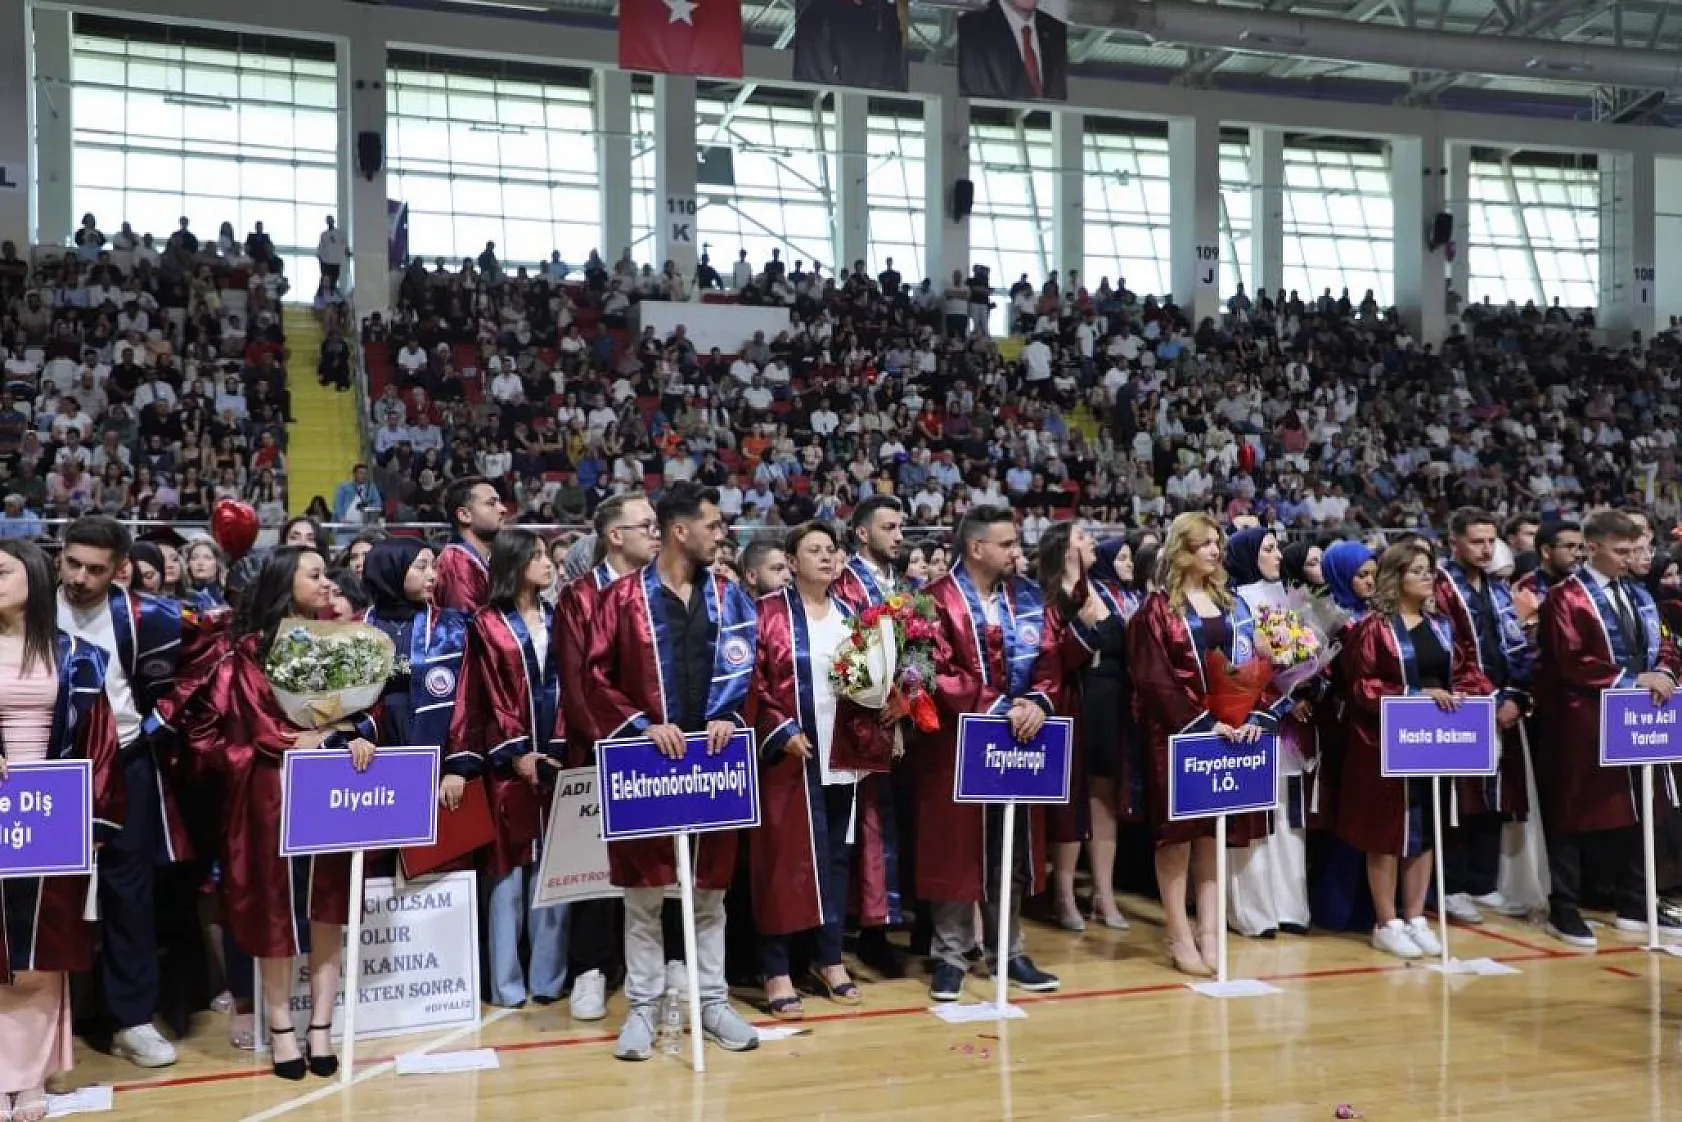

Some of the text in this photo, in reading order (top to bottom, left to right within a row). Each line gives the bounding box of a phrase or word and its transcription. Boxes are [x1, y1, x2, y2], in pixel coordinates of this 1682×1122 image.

[667, 198, 696, 215] 110
[673, 223, 690, 242] K
[1196, 245, 1219, 261] 109
[1201, 267, 1214, 284] J
[1398, 727, 1477, 744] Hasta Bakımı
[984, 743, 1046, 776] Fizyoterapi
[1184, 748, 1267, 775] Fizyoterapi
[611, 760, 747, 801] Elektronörofizyoloji
[1211, 771, 1240, 793] İ.Ö.
[20, 790, 53, 817] Diş
[329, 786, 396, 812] Diyaliz
[385, 892, 452, 913] OLSAM
[360, 925, 411, 946] OLUR
[363, 951, 439, 976] KANINA
[408, 976, 467, 999] SONRA
